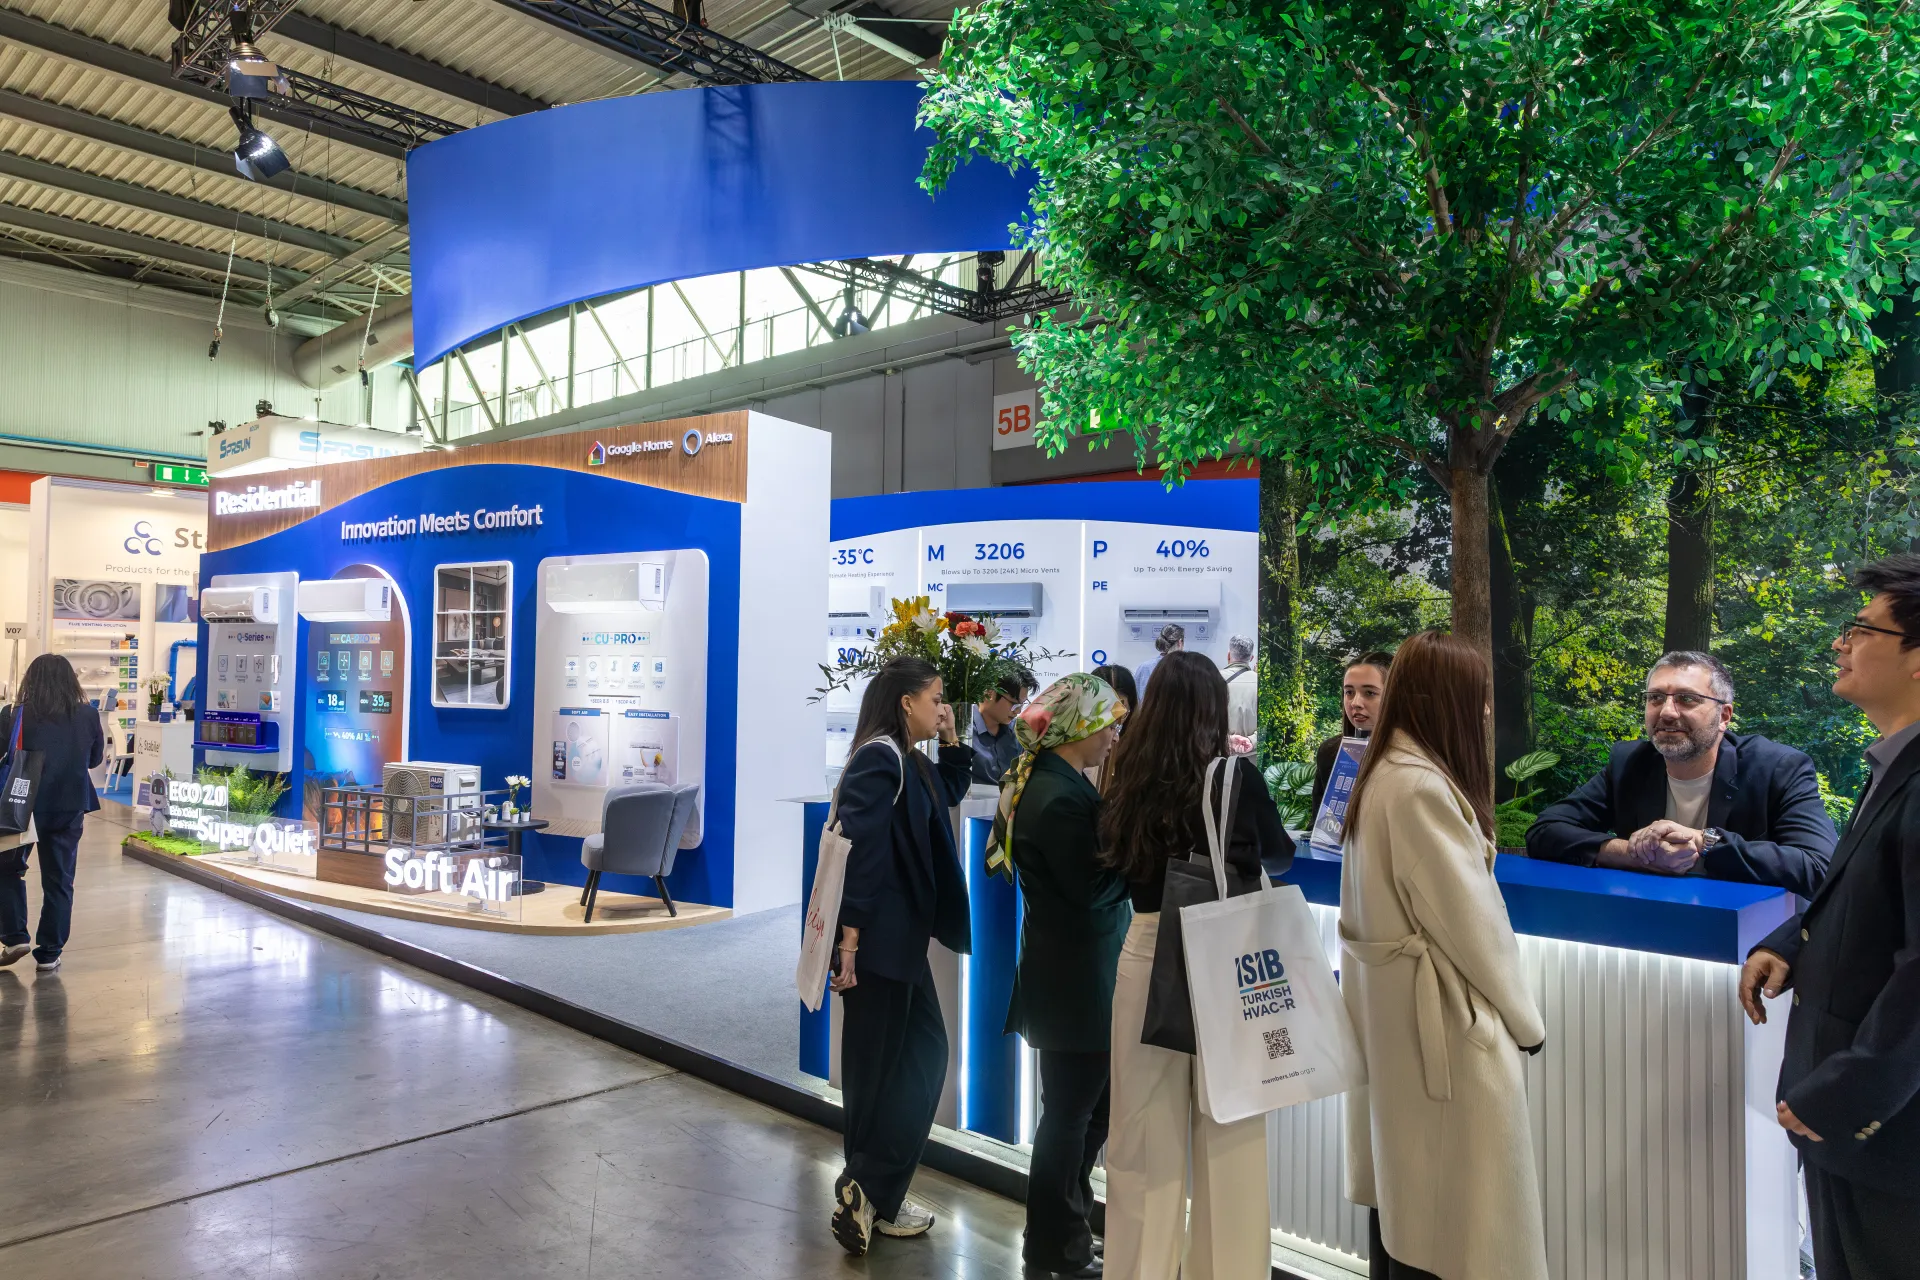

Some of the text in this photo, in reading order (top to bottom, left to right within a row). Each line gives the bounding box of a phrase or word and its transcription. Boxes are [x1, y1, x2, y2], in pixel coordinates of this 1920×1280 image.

[997, 405, 1031, 435] 5B
[705, 432, 733, 444] Alexa
[607, 440, 673, 456] Google Home
[215, 479, 322, 515] Residential
[341, 504, 543, 539] Innovation Meets Comfort
[174, 527, 209, 549] St
[927, 545, 945, 561] M
[974, 542, 1025, 560] 3206
[1093, 540, 1108, 558] P
[1156, 540, 1210, 558] 40%
[105, 564, 153, 575] Products
[156, 566, 170, 575] for
[173, 567, 190, 576] the
[1206, 565, 1233, 573] Saving
[927, 583, 943, 592] MC
[1092, 581, 1108, 590] PE
[236, 632, 264, 642] Q-Series
[594, 633, 636, 644] CU-PRO
[1091, 650, 1107, 666] Q
[327, 693, 338, 706] 18
[371, 694, 385, 707] 39
[430, 776, 443, 784] AUX
[169, 780, 227, 807] ECO 2.0
[197, 815, 316, 856] Super Quiet
[384, 847, 518, 902] Soft Air
[1240, 985, 1292, 1006] TURKISH
[1243, 998, 1297, 1021] HVAC-R
